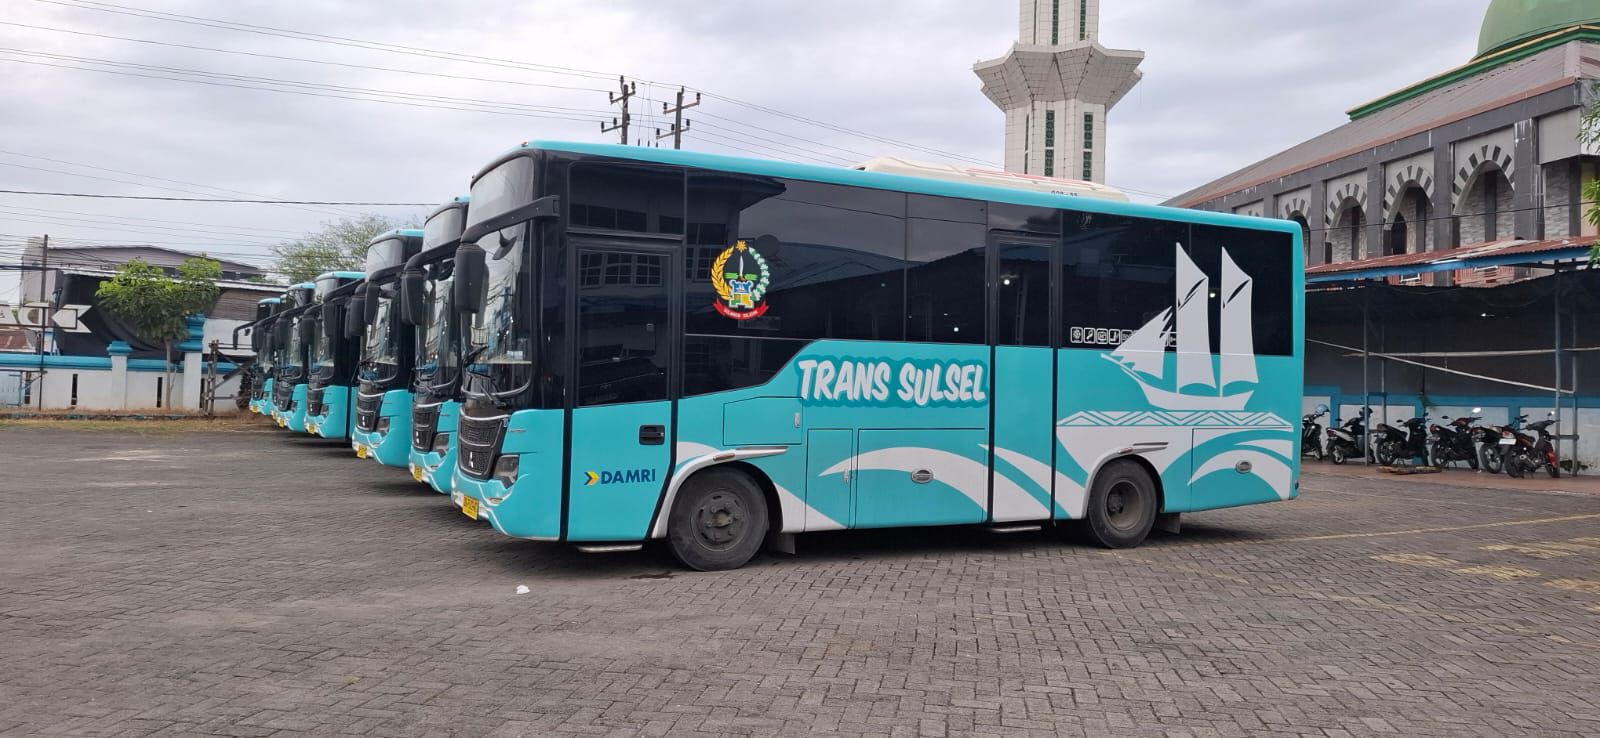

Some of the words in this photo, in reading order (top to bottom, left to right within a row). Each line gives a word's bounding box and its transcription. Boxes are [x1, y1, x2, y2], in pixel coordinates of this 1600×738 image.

[798, 359, 890, 401] TRANS
[896, 362, 986, 406] SULSEL
[601, 468, 656, 484] DAMRI
